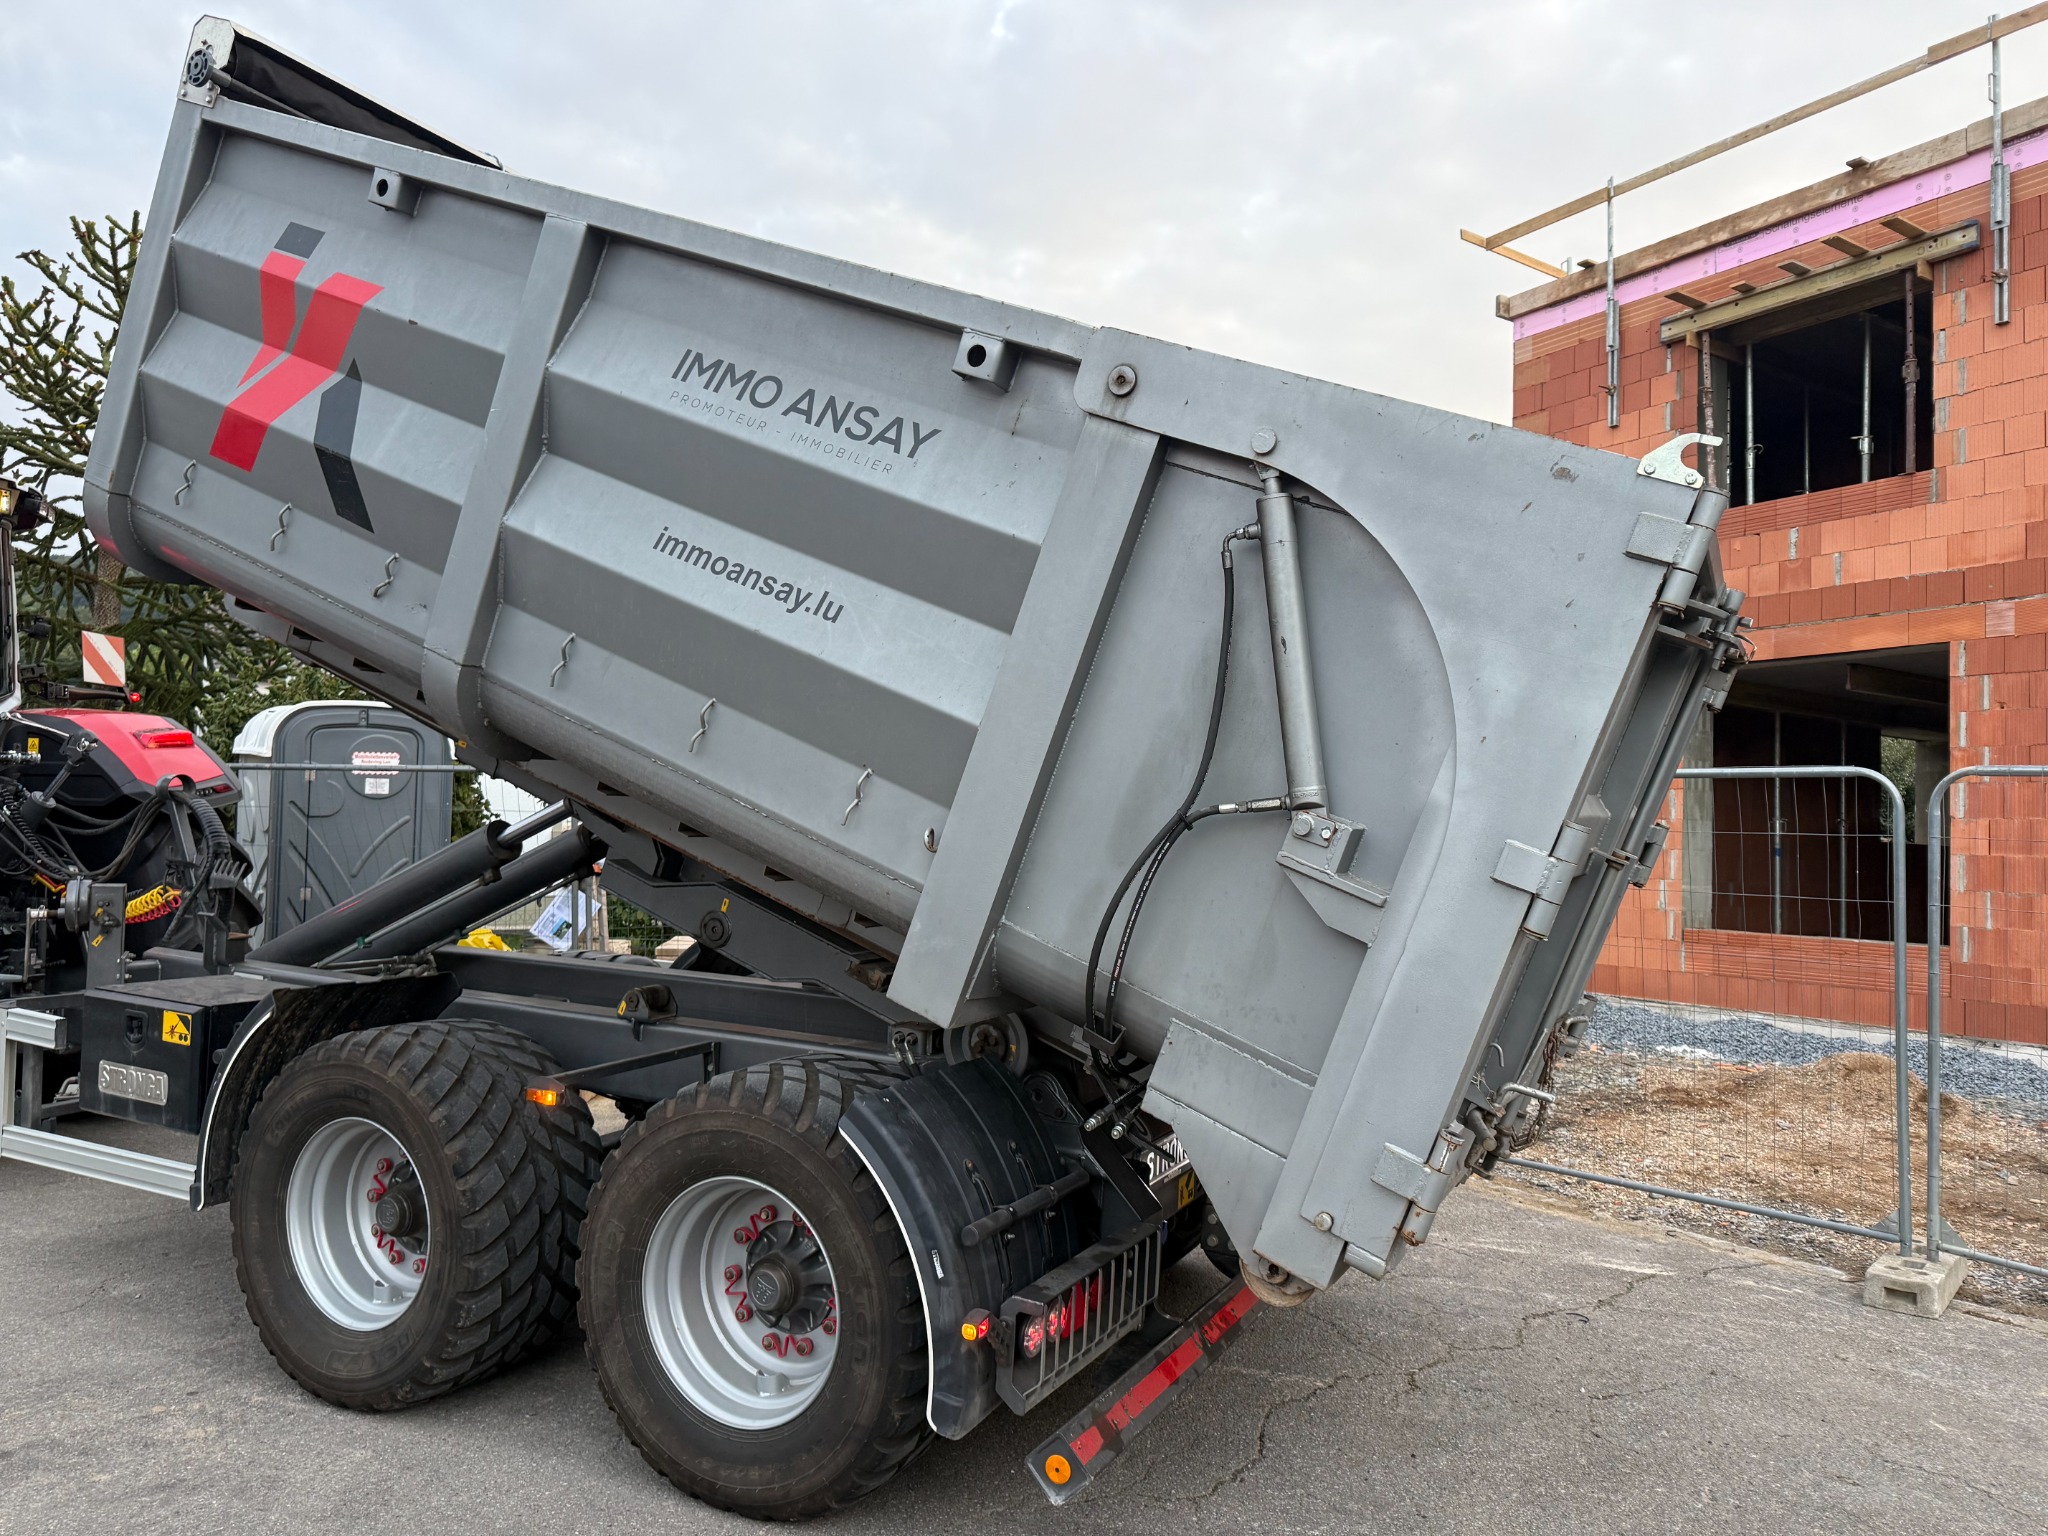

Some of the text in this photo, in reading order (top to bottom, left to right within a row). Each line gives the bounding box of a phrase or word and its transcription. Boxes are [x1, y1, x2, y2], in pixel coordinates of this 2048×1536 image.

[669, 390, 767, 432] PROMOTEUR
[790, 431, 894, 475] IMMOBILIER
[671, 348, 942, 460] IMMO ANSAY
[652, 526, 845, 624] immoansay.lu
[101, 1064, 165, 1102] STRONGA
